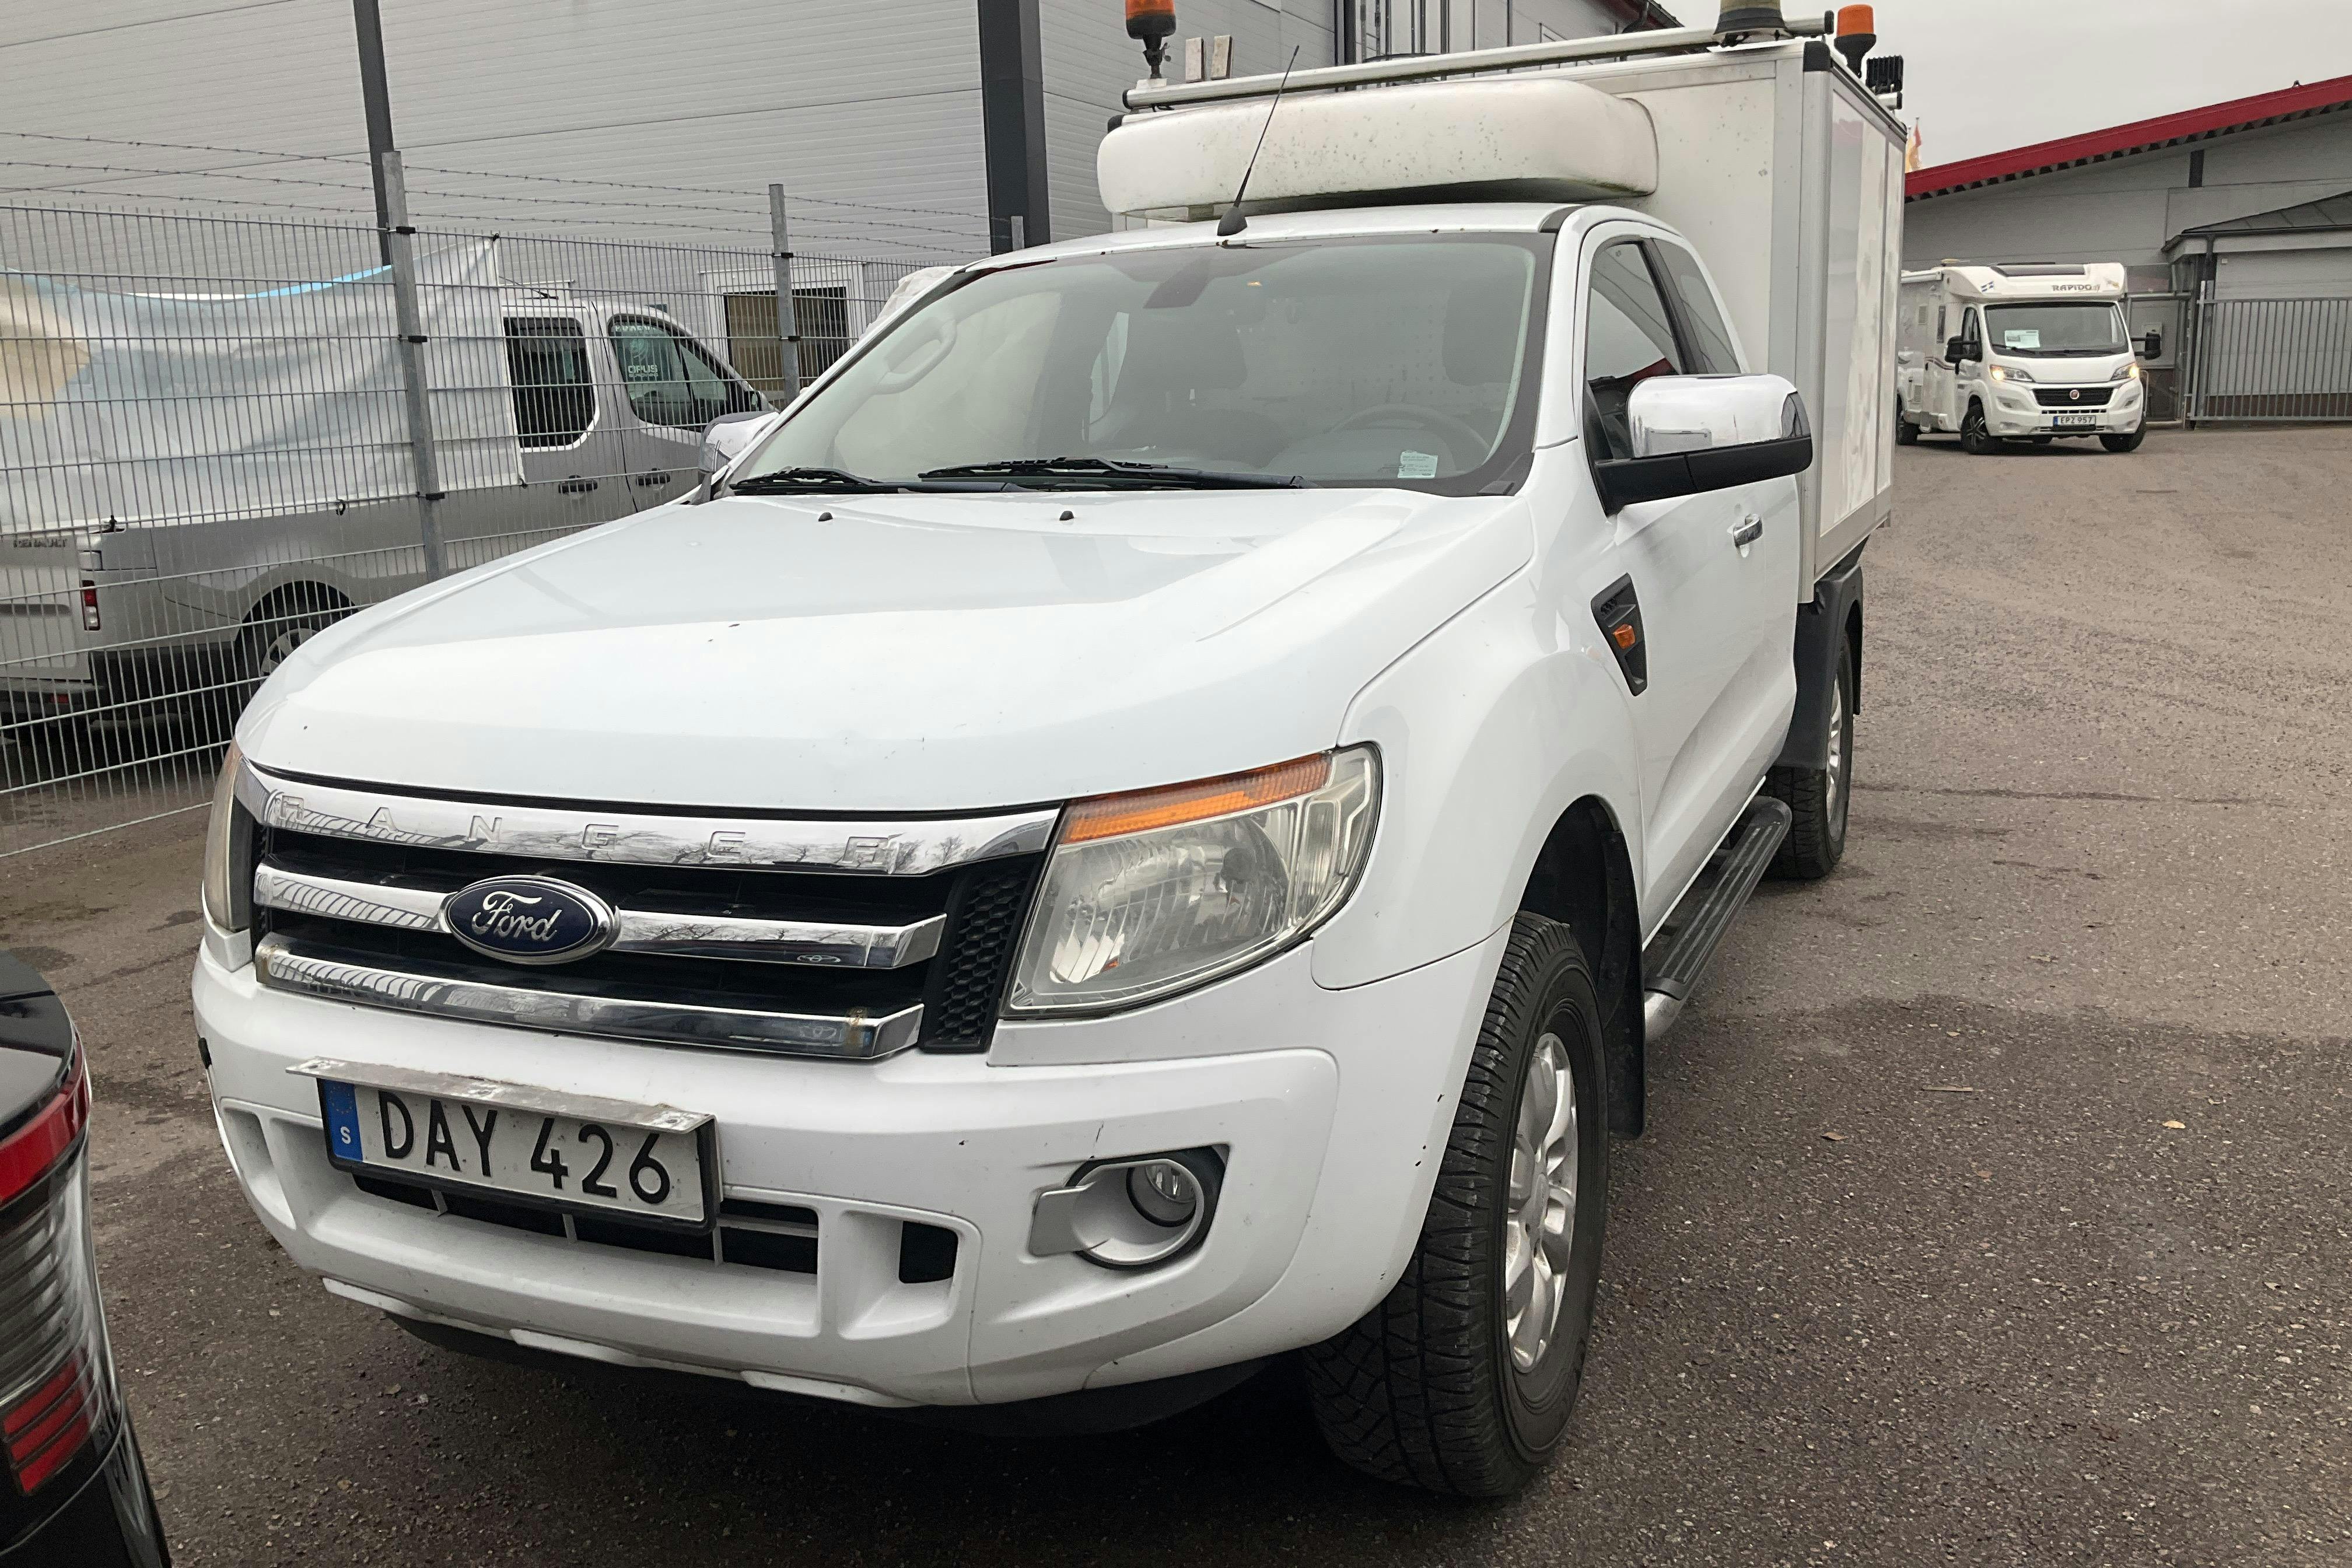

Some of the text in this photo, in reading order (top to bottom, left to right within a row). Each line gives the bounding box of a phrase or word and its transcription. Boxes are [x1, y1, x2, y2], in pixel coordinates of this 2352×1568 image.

[628, 365, 658, 373] OPUS
[280, 795, 888, 866] RANGER
[471, 891, 562, 942] Ford
[340, 1126, 351, 1145] S
[377, 1090, 671, 1205] DAY 426
